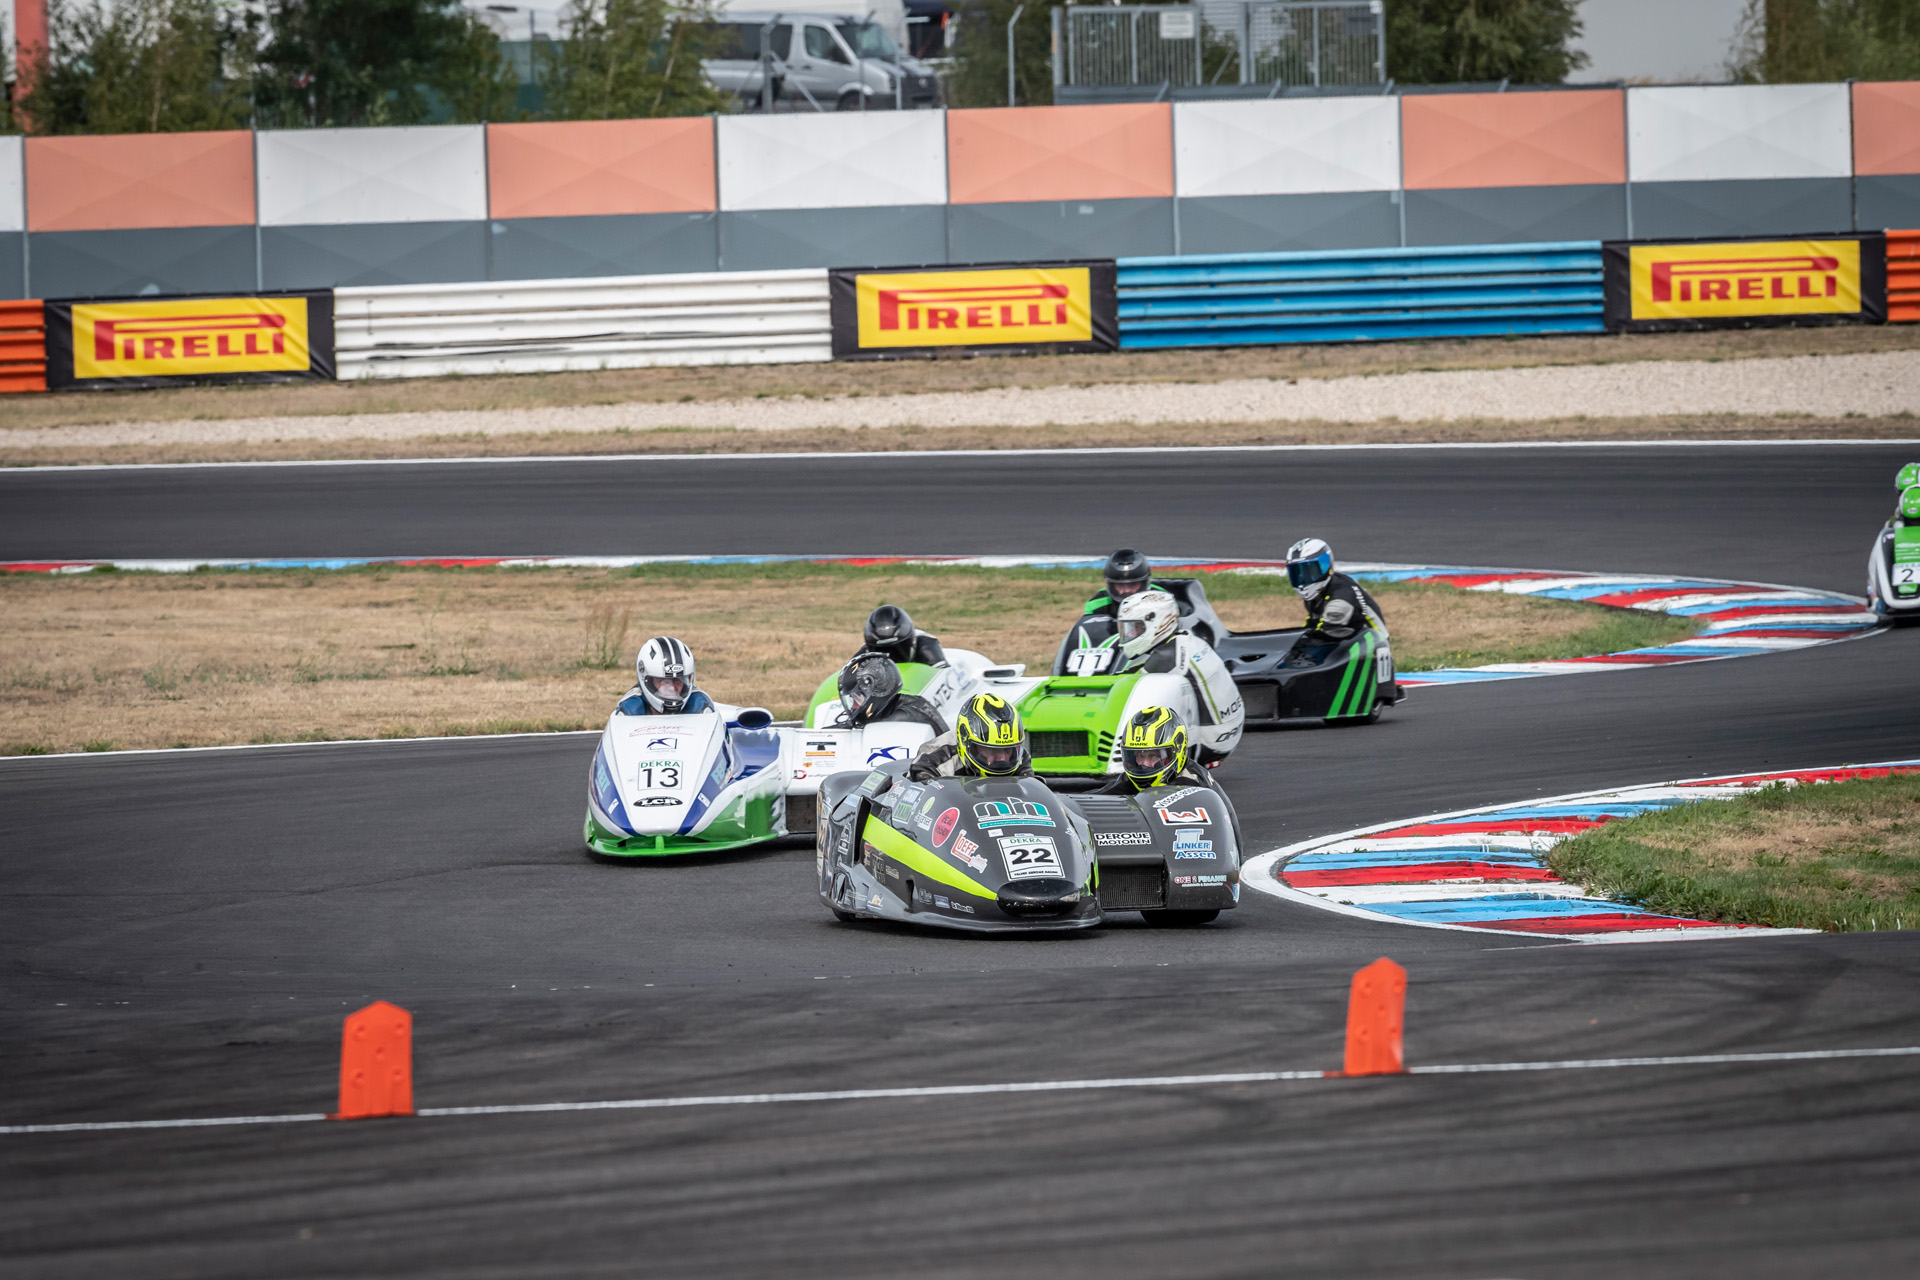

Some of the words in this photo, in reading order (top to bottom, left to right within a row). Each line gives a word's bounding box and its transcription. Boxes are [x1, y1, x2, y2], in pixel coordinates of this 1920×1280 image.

[1651, 257, 1839, 302] PIRELLI
[879, 285, 1069, 330] PIRELLI
[94, 314, 286, 360] PIRELLI
[1076, 654, 1103, 669] 11
[641, 760, 681, 769] DEKRA
[642, 768, 680, 788] 13
[1096, 832, 1150, 840] DEROUE
[1010, 848, 1055, 865] 22
[1177, 851, 1216, 859] Assen
